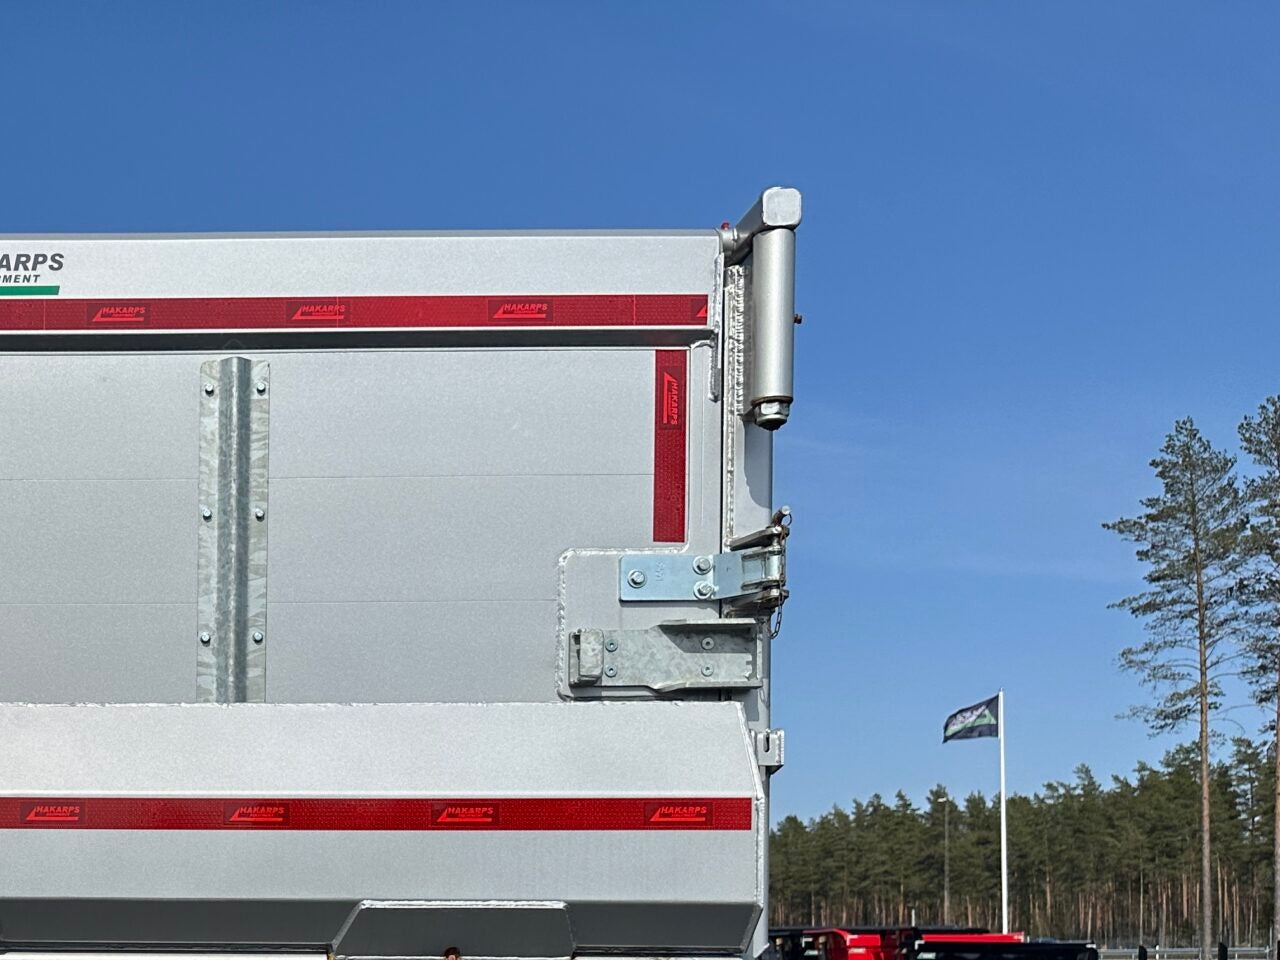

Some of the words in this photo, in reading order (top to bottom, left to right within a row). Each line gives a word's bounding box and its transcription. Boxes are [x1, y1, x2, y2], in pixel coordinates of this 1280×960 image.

[102, 306, 146, 314] HAKARPS
[302, 304, 346, 312] HAKARPS
[503, 303, 548, 311] HAKARPS
[36, 805, 80, 814] HAKARPS
[239, 806, 285, 814] HAKARPS
[447, 806, 494, 815] HAKARPS
[660, 806, 707, 814] HAKARPS
